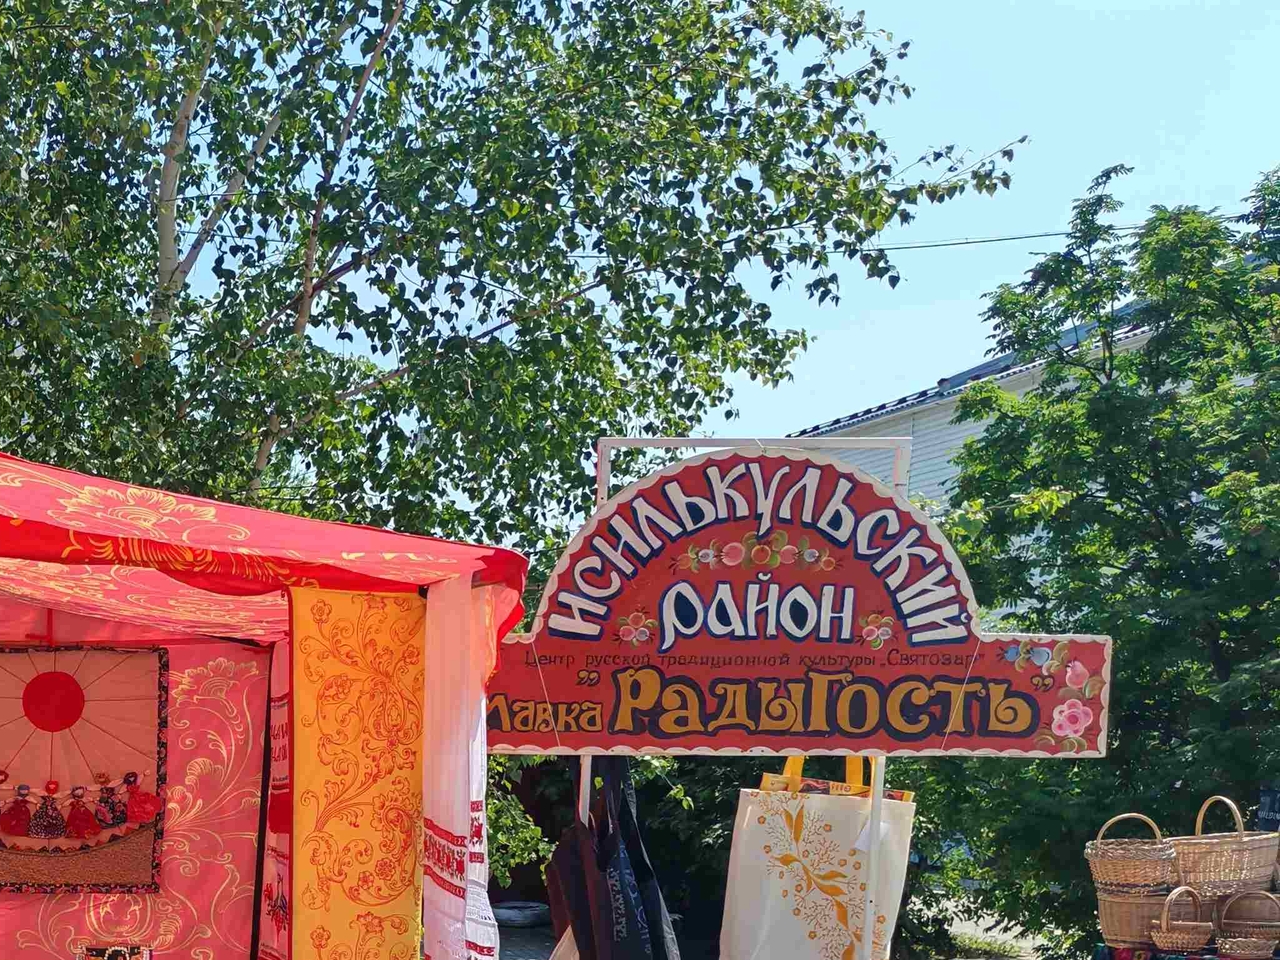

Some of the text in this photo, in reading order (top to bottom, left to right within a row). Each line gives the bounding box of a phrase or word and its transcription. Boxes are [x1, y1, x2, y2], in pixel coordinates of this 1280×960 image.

[525, 651, 575, 667] Центр
[585, 652, 651, 667] русской
[658, 652, 791, 668] традиционной
[799, 653, 876, 668] культуры
